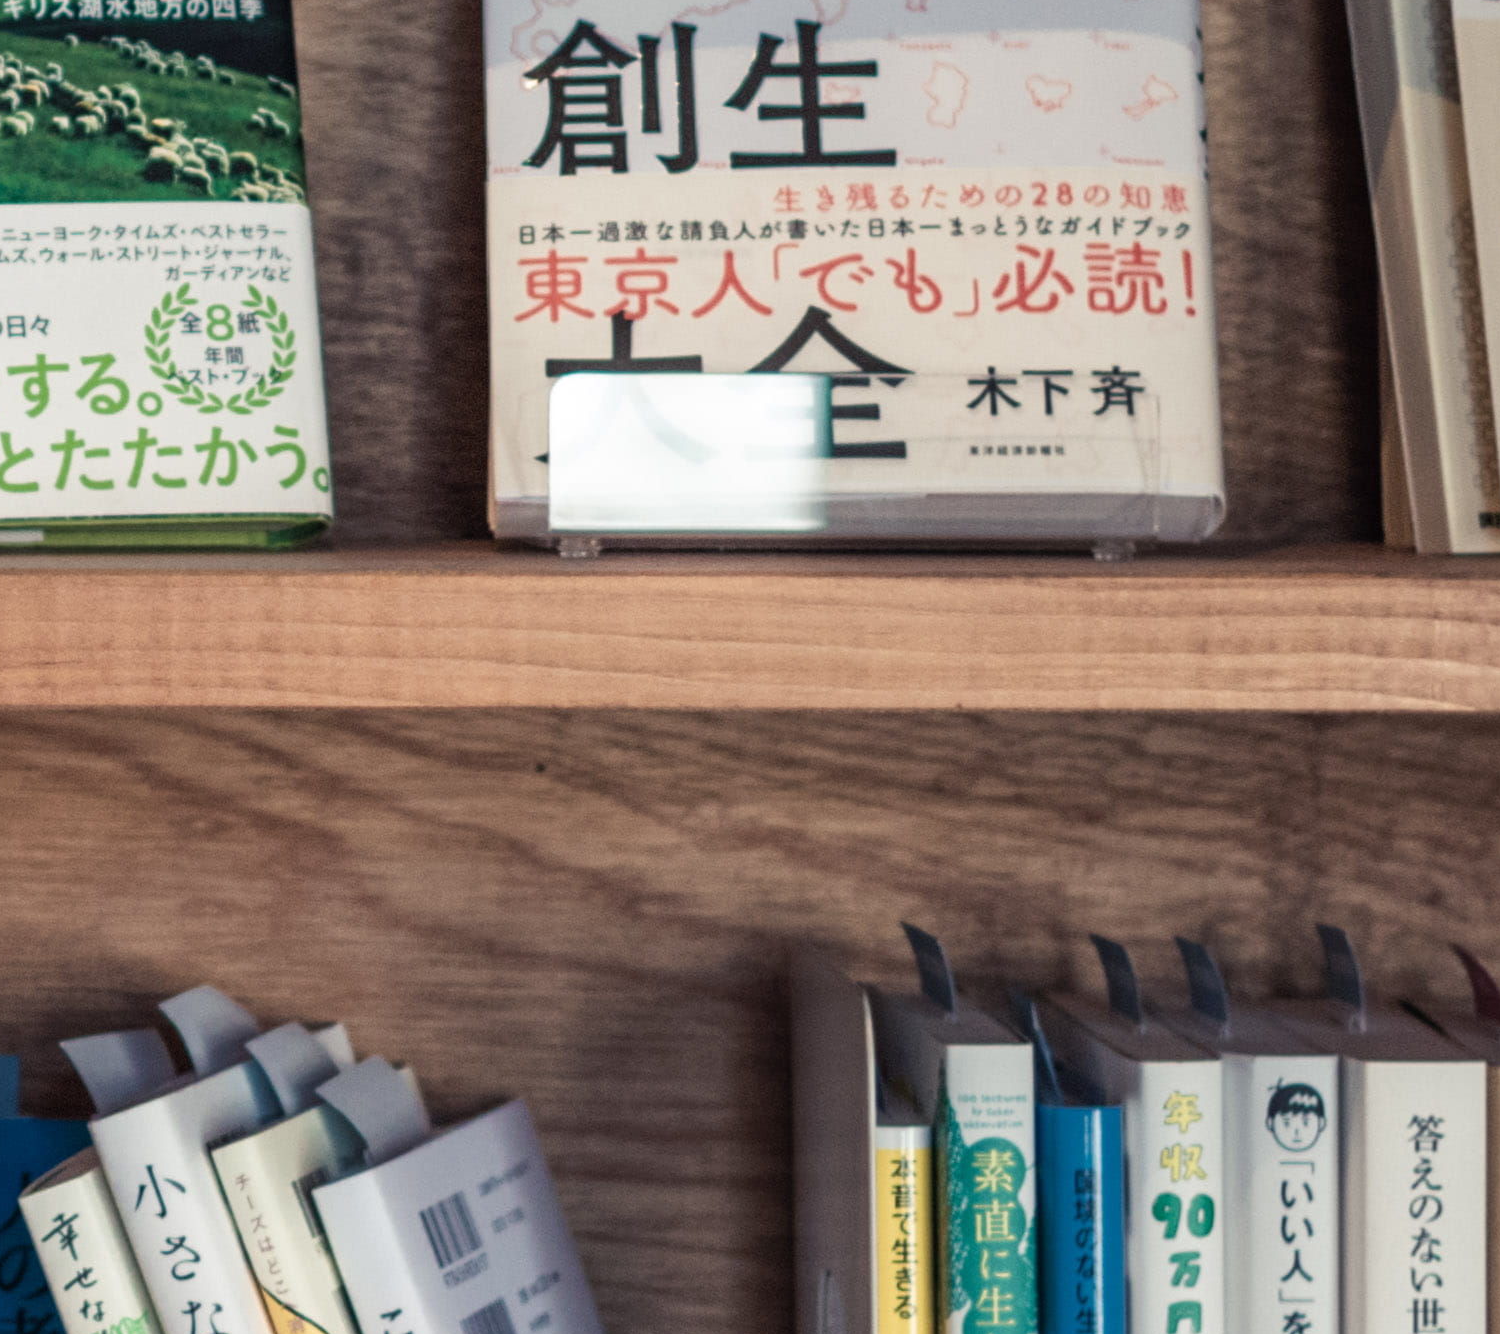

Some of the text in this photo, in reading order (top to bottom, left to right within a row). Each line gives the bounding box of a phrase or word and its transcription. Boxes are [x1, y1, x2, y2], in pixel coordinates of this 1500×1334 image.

[522, 18, 898, 176] 創生
[773, 183, 1190, 215] 生き残るための28の知恵
[1, 223, 288, 243] ニューヨーク・タイムズ・ベストセラー
[517, 215, 1193, 246] 日本一過激な請負人が書いた日本一まっとうなガイドブック
[165, 265, 292, 283] ガーディアンなど
[514, 243, 1198, 324] 東京人「でも」必読!
[179, 303, 262, 343] 全8紙
[203, 346, 245, 366] 年間
[166, 366, 284, 387] ベスト・ブック
[890, 1154, 918, 1322] 本音で生きる
